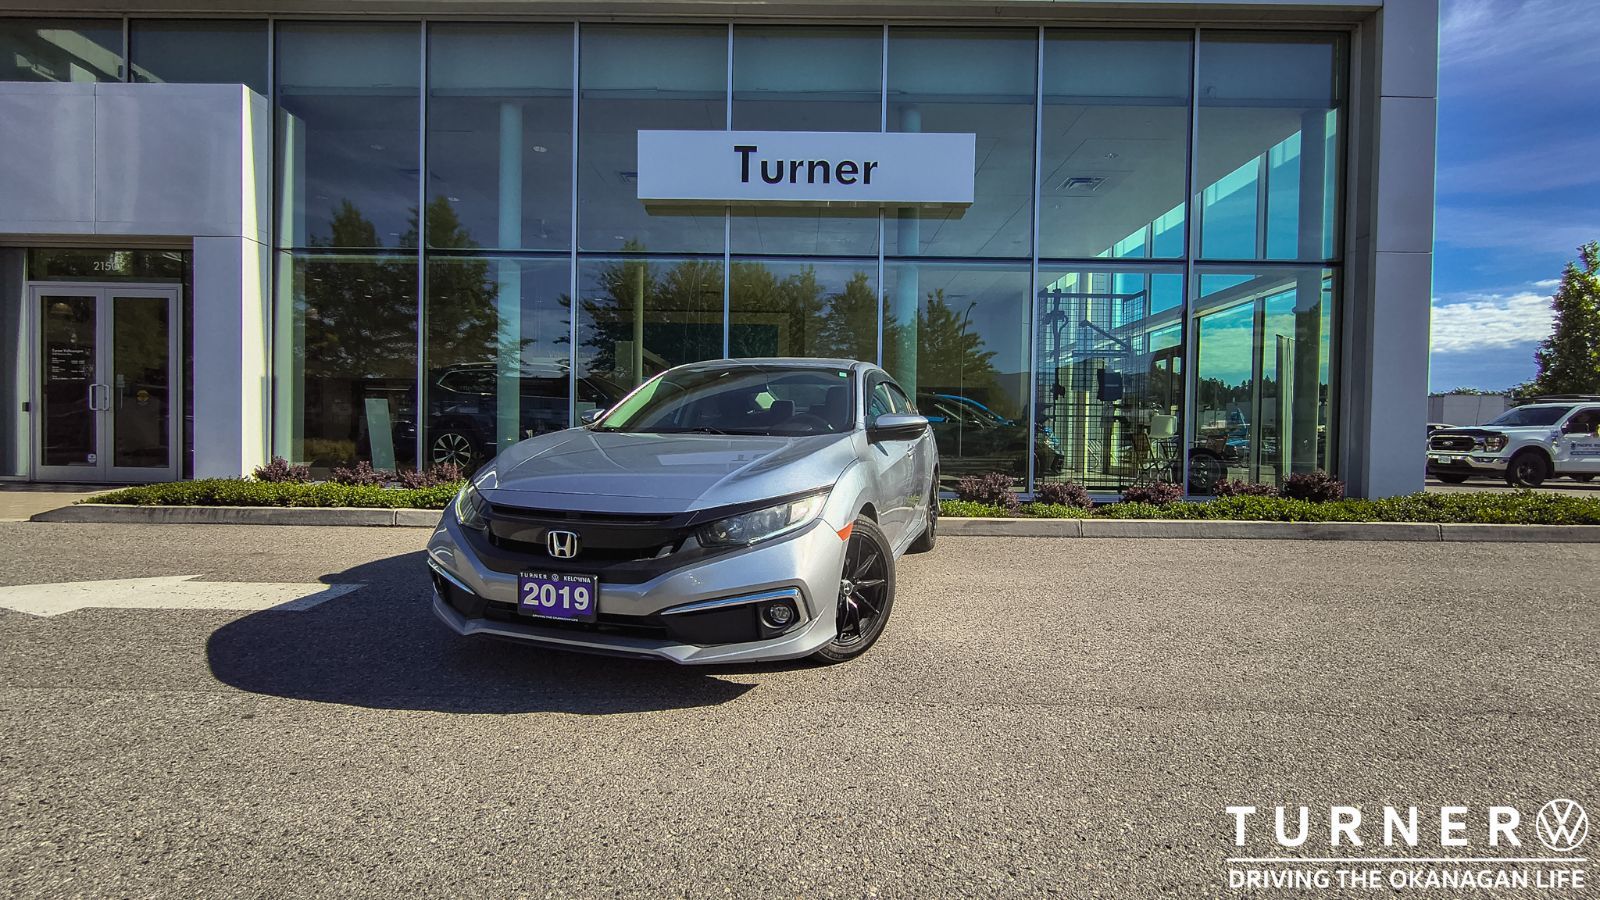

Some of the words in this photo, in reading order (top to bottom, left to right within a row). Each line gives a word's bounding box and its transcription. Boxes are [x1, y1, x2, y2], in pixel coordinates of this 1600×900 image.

[734, 146, 878, 185] Turner
[520, 572, 547, 580] TURNER
[523, 582, 589, 611] 2019
